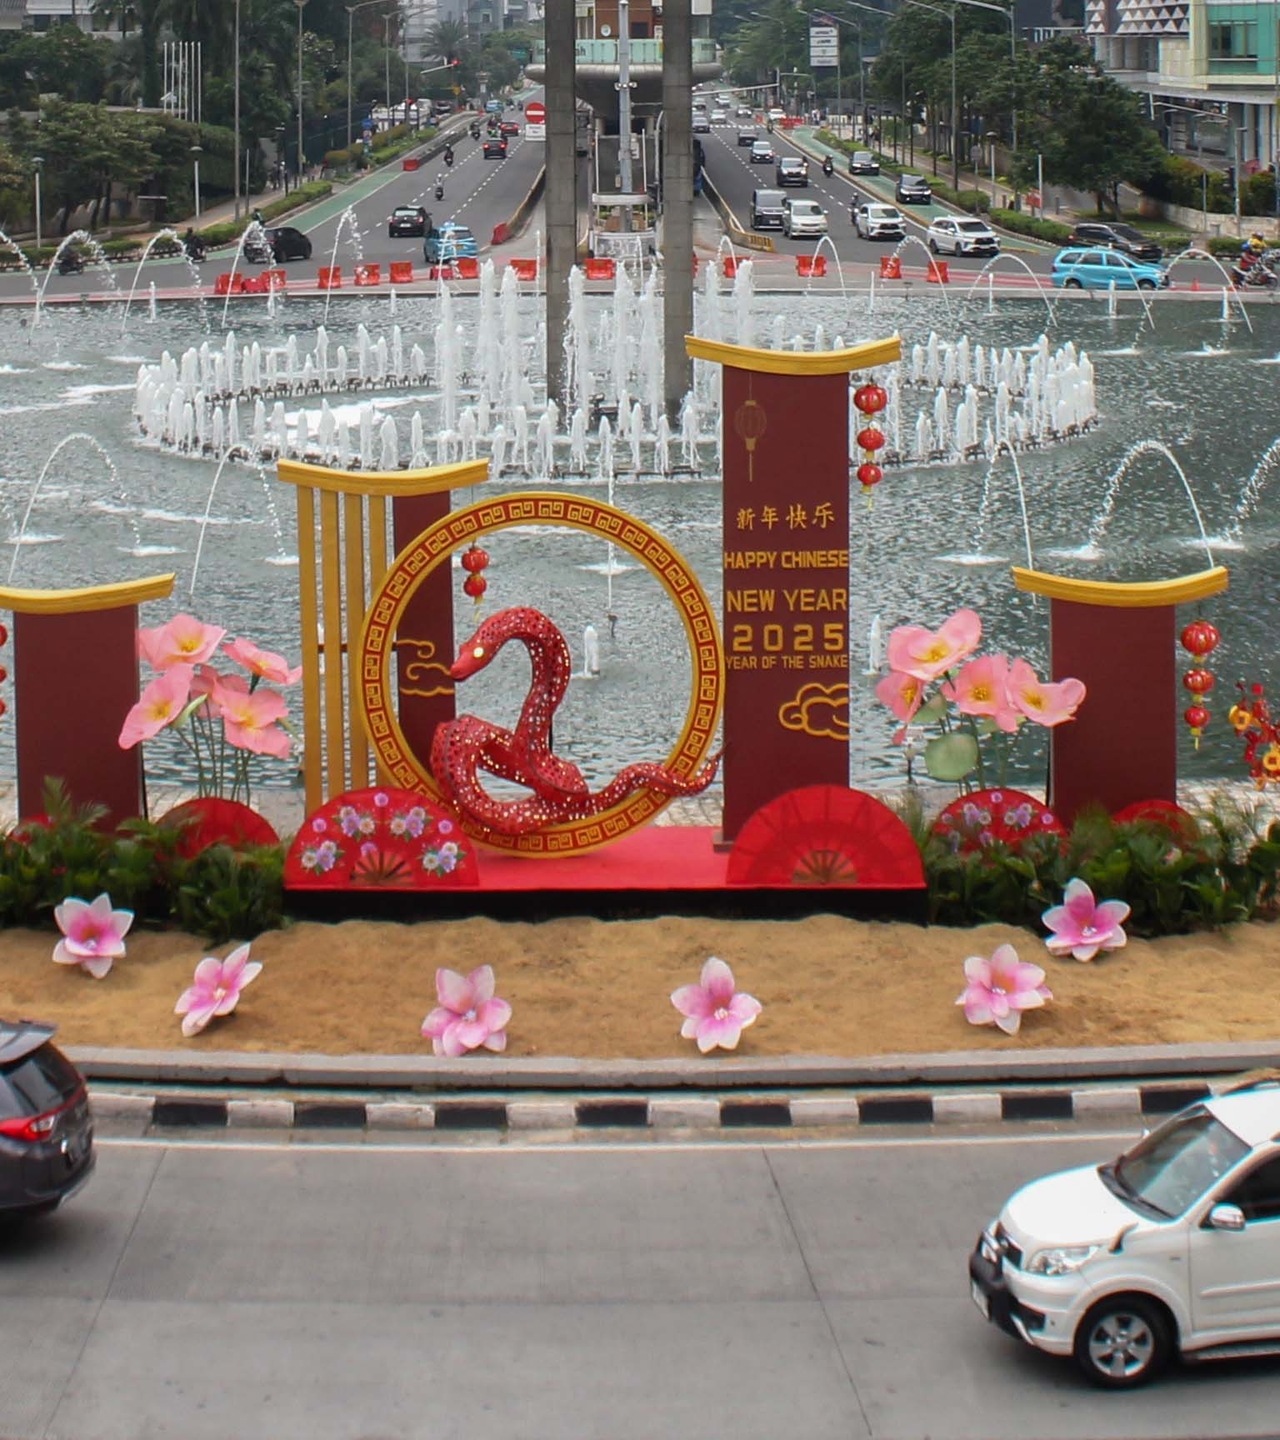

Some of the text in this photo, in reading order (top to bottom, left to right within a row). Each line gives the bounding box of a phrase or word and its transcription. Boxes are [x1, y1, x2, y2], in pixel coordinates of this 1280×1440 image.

[736, 502, 835, 531] 新年快乐
[724, 549, 849, 569] HAPPY CHINESE
[726, 588, 847, 612] NEW YEAR
[732, 623, 845, 652] 2025
[725, 654, 848, 670] YEAR OF THE SNAKE
